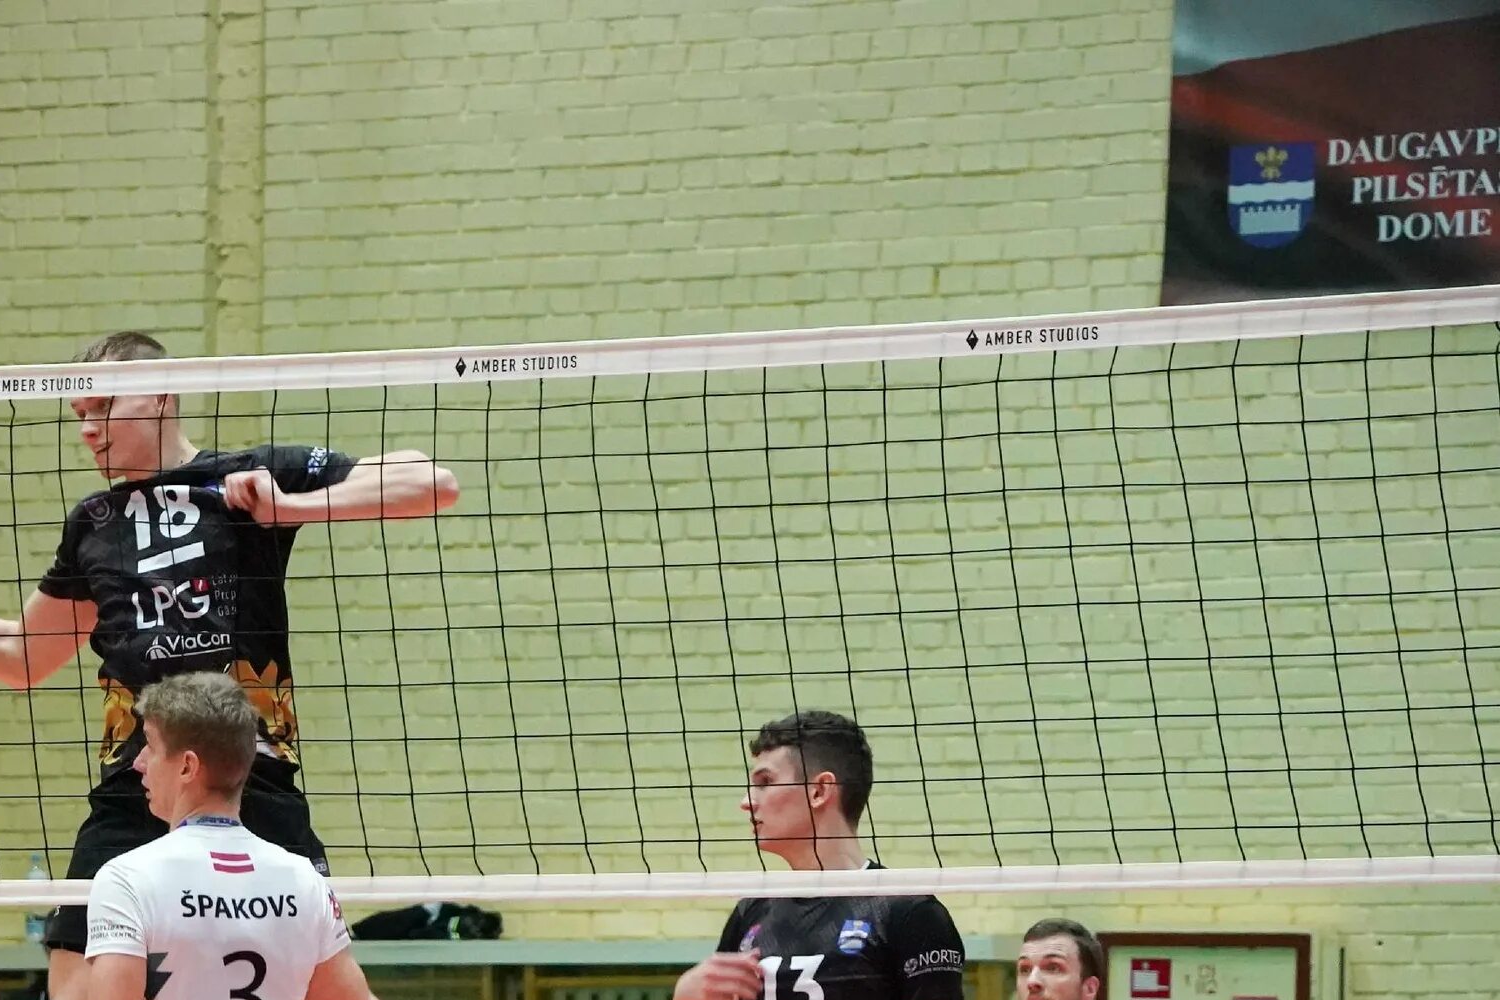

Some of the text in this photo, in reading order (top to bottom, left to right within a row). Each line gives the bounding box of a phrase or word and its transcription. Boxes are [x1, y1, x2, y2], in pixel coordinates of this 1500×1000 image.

[1326, 127, 1500, 166] DAUGAVP
[1351, 165, 1500, 204] PILSĒTA
[1377, 208, 1492, 242] DOME
[985, 326, 1099, 346] AMBER STUDIOS
[472, 355, 577, 373] AMBER STUDIOS
[41, 377, 93, 392] STUDIOS
[124, 485, 201, 551] 18
[132, 580, 211, 630] LPG
[166, 632, 230, 651] ViaCon
[180, 890, 298, 919] ŠPAKOVS
